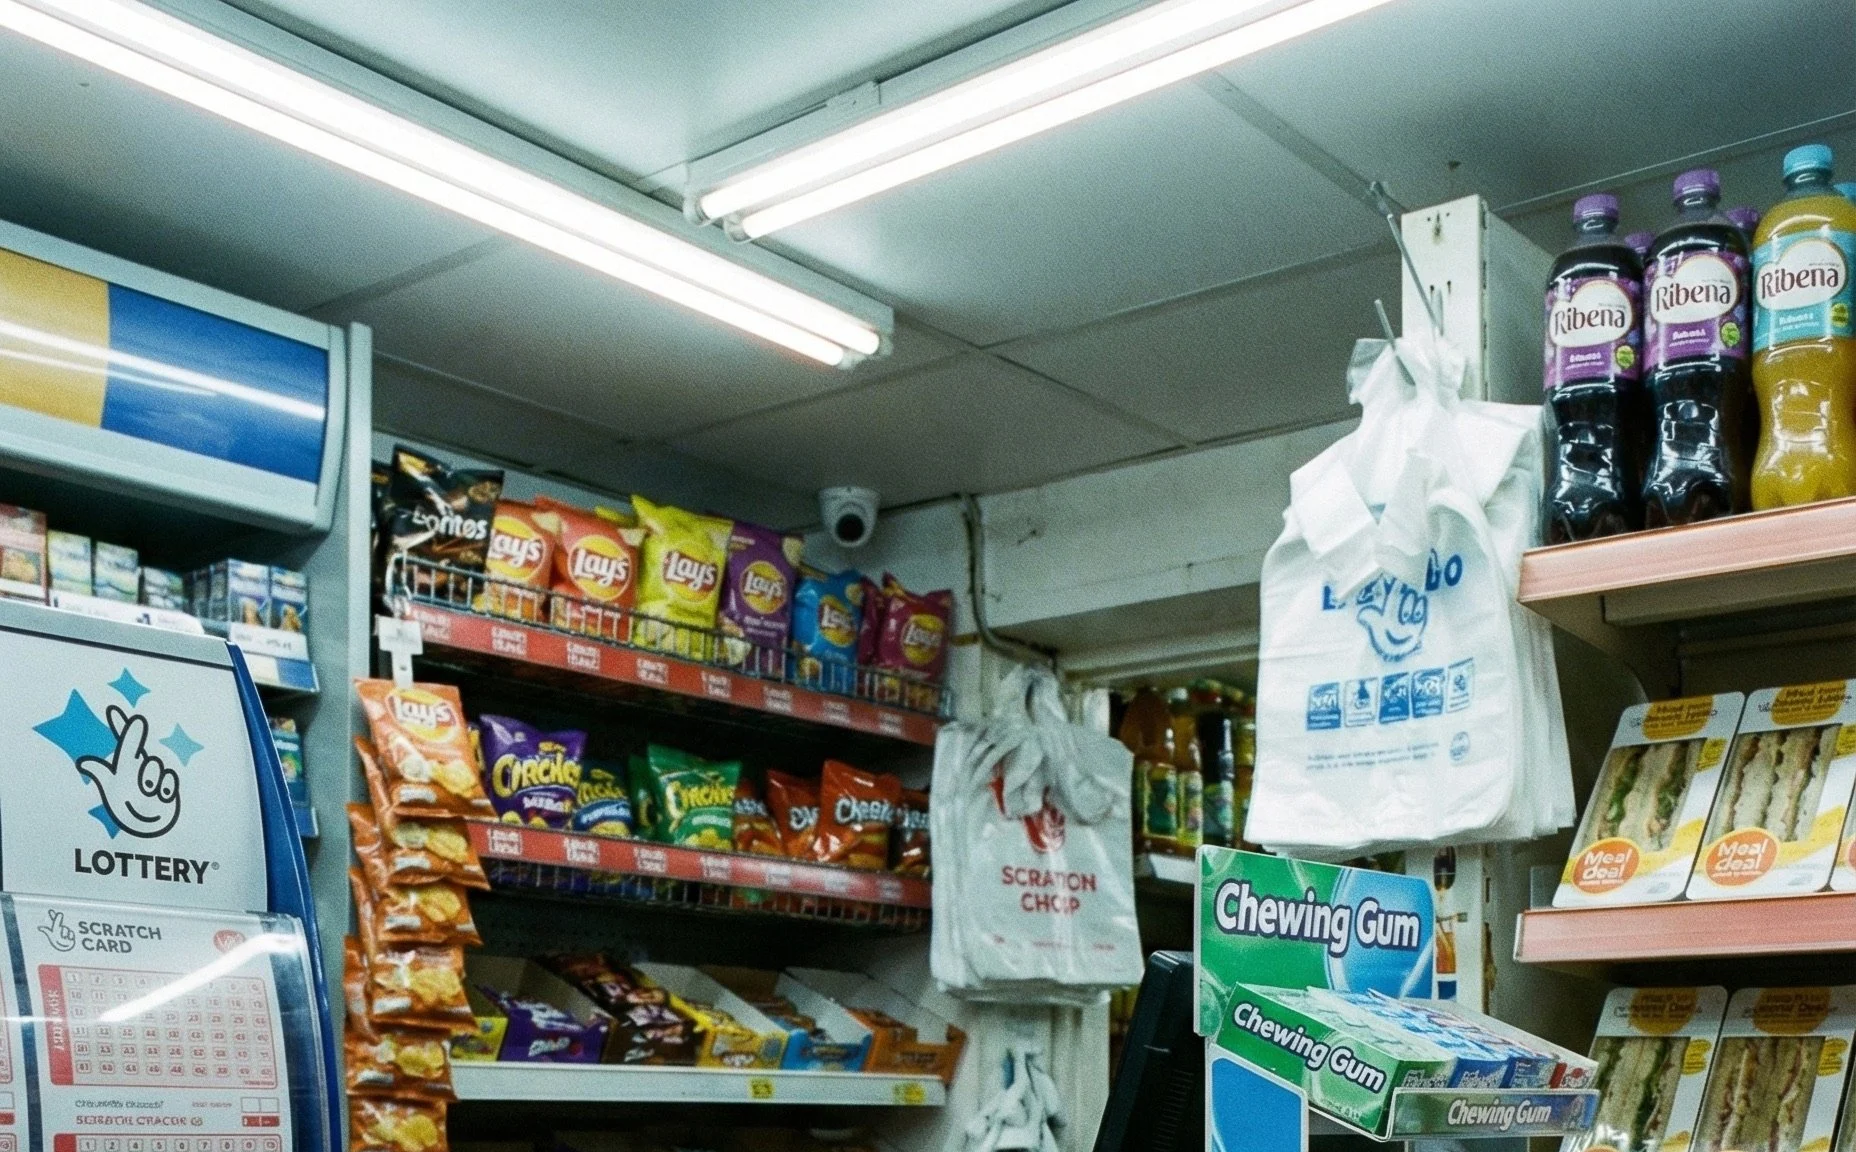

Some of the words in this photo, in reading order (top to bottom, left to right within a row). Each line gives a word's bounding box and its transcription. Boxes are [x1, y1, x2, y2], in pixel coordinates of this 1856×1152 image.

[1656, 281, 1731, 313] Ribena
[1762, 265, 1839, 299] Ribena
[1554, 308, 1627, 335] Ribena
[1584, 849, 1632, 866] Meal
[1719, 839, 1768, 857] Meal
[75, 848, 210, 884] LOTTERY
[78, 920, 162, 941] SCRATCH
[1215, 882, 1351, 954] Chewing
[1355, 899, 1420, 947] Gum
[82, 938, 132, 953] CARD
[1233, 1003, 1329, 1069] Chewing
[1330, 1048, 1385, 1091] Gum
[1447, 1098, 1515, 1132] Chewing
[1515, 1100, 1552, 1125] Gum
